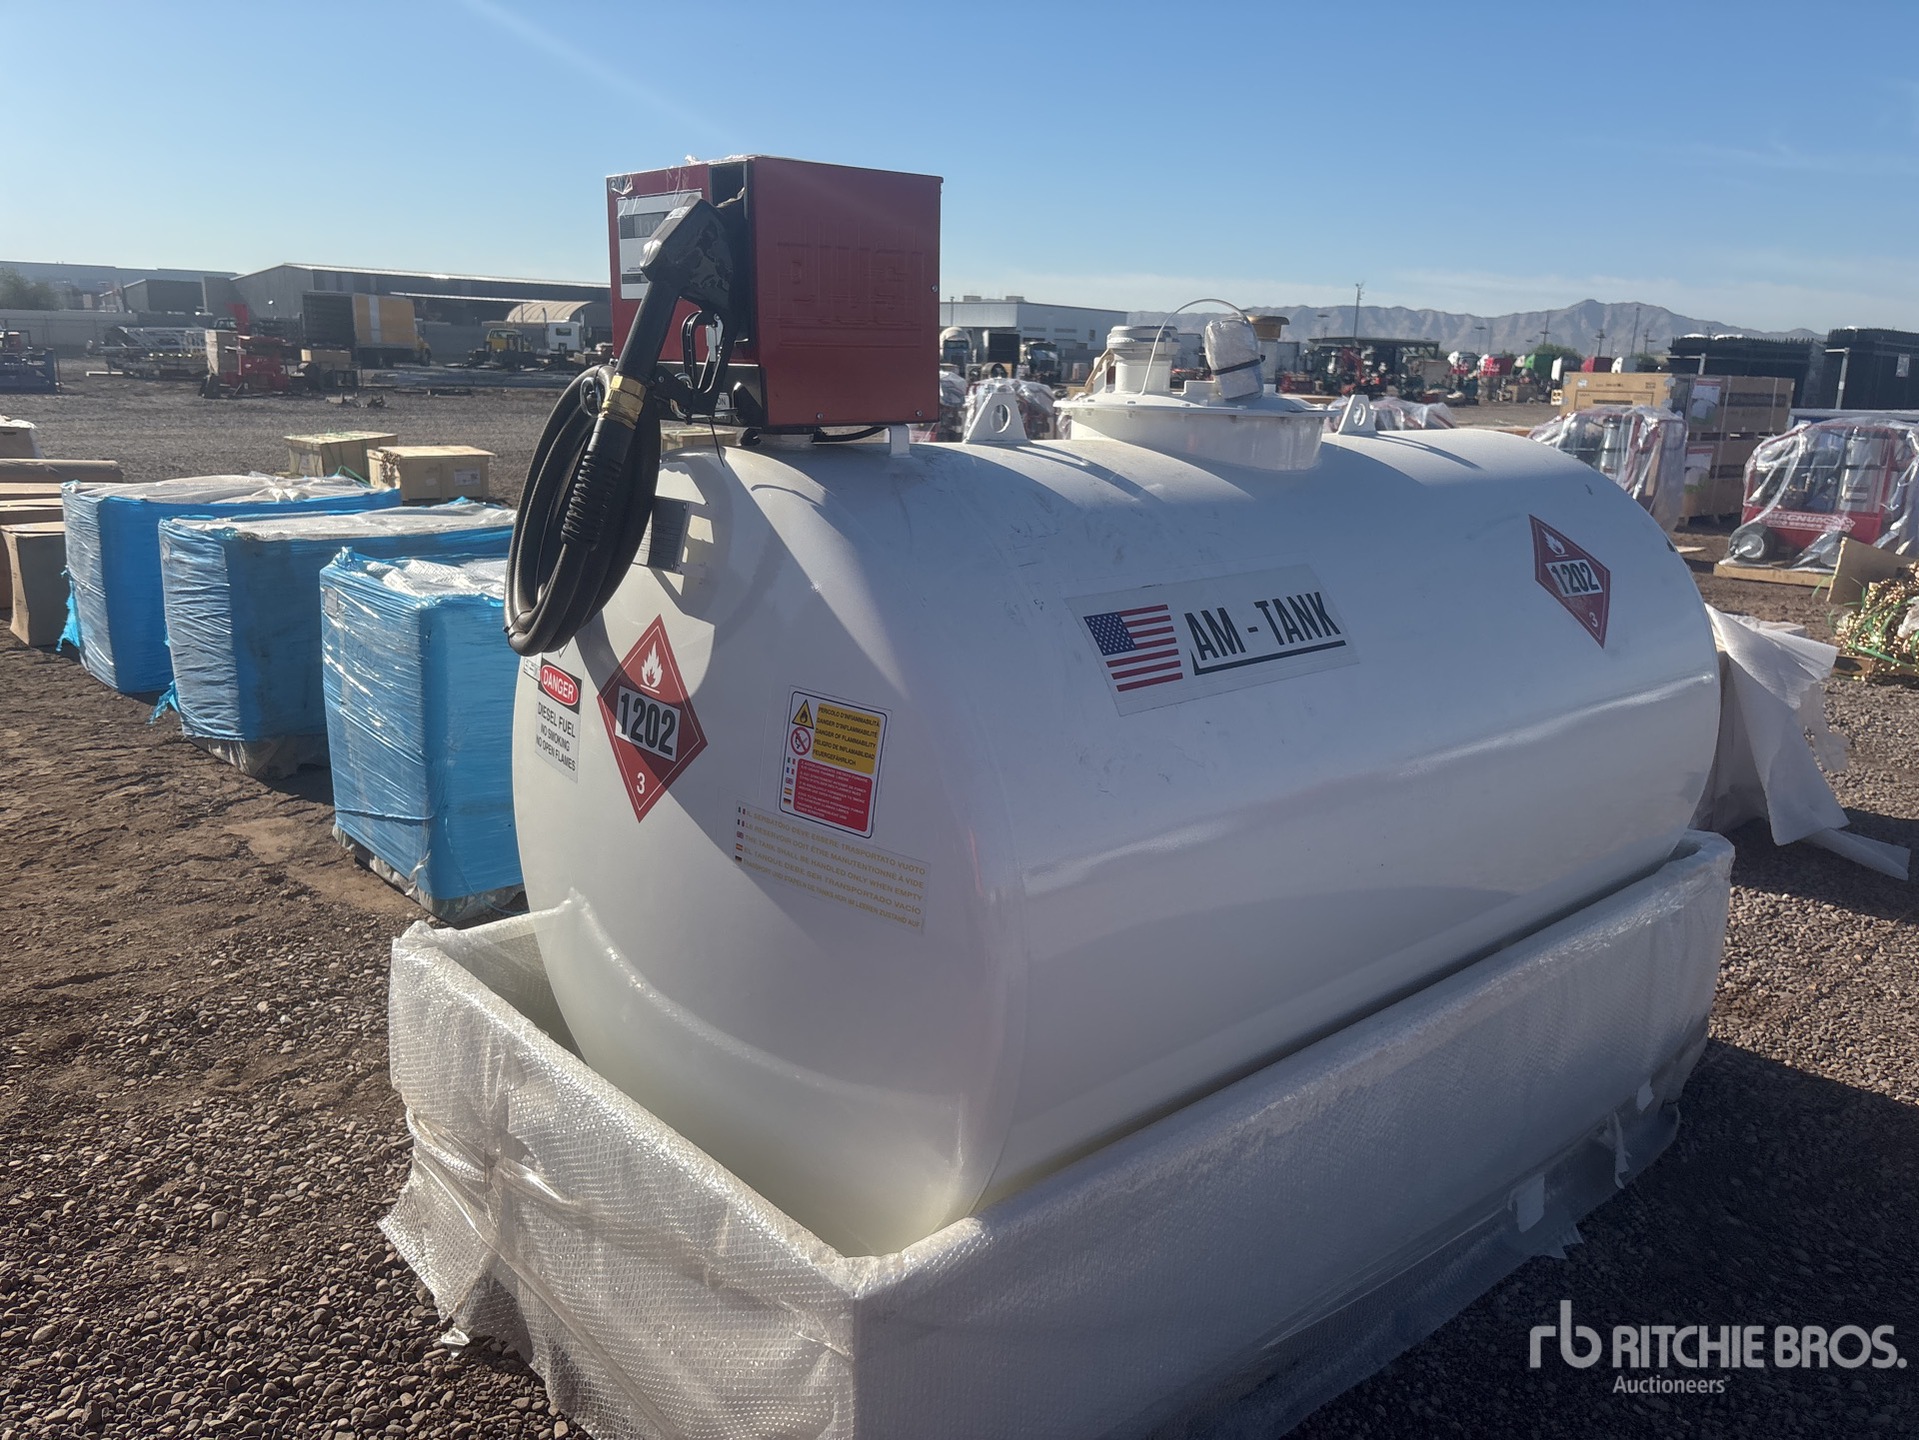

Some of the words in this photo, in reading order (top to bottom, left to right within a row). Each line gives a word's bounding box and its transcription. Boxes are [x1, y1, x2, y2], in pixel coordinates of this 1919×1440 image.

[1551, 562, 1600, 595] 1202
[1184, 607, 1247, 661] AM
[1254, 591, 1341, 646] TANK
[1589, 611, 1598, 628] 3
[543, 669, 574, 701] DANGER
[538, 702, 557, 727] DIESEL
[559, 715, 576, 738] FUEL
[620, 692, 676, 757] 1202
[817, 717, 835, 727] DANGER
[536, 734, 542, 748] NO
[543, 740, 555, 757] OPEN
[555, 749, 576, 772] FLAMES
[541, 723, 548, 736] NO
[548, 728, 570, 752] SMOKING
[814, 738, 832, 749] PELIGRO
[815, 728, 834, 738] DANGER
[835, 732, 841, 740] OF
[842, 735, 876, 748] FLAMMABILITY
[636, 771, 646, 795] 3
[753, 812, 790, 831] SERBATOIO
[792, 827, 810, 838] DEVE
[811, 833, 839, 848] ESSERE
[841, 843, 896, 866] TRASPORTATO
[897, 862, 925, 875] VUOTO
[744, 847, 752, 855] EL
[755, 851, 782, 867] TANQUE
[784, 862, 806, 875] DEBE
[806, 870, 822, 880] SER
[825, 877, 892, 905] TRANSPORTADO
[894, 900, 921, 915] VACÍO
[745, 835, 757, 844] THE
[760, 841, 775, 852] TANK
[777, 847, 798, 860] SHALL
[800, 855, 809, 864] BE
[811, 860, 846, 876] HANDLED
[847, 871, 869, 884] ONLY
[869, 879, 893, 893] WHEN
[894, 887, 923, 900] EMPTY
[792, 840, 809, 850] DOIT
[905, 878, 924, 889] VIDE
